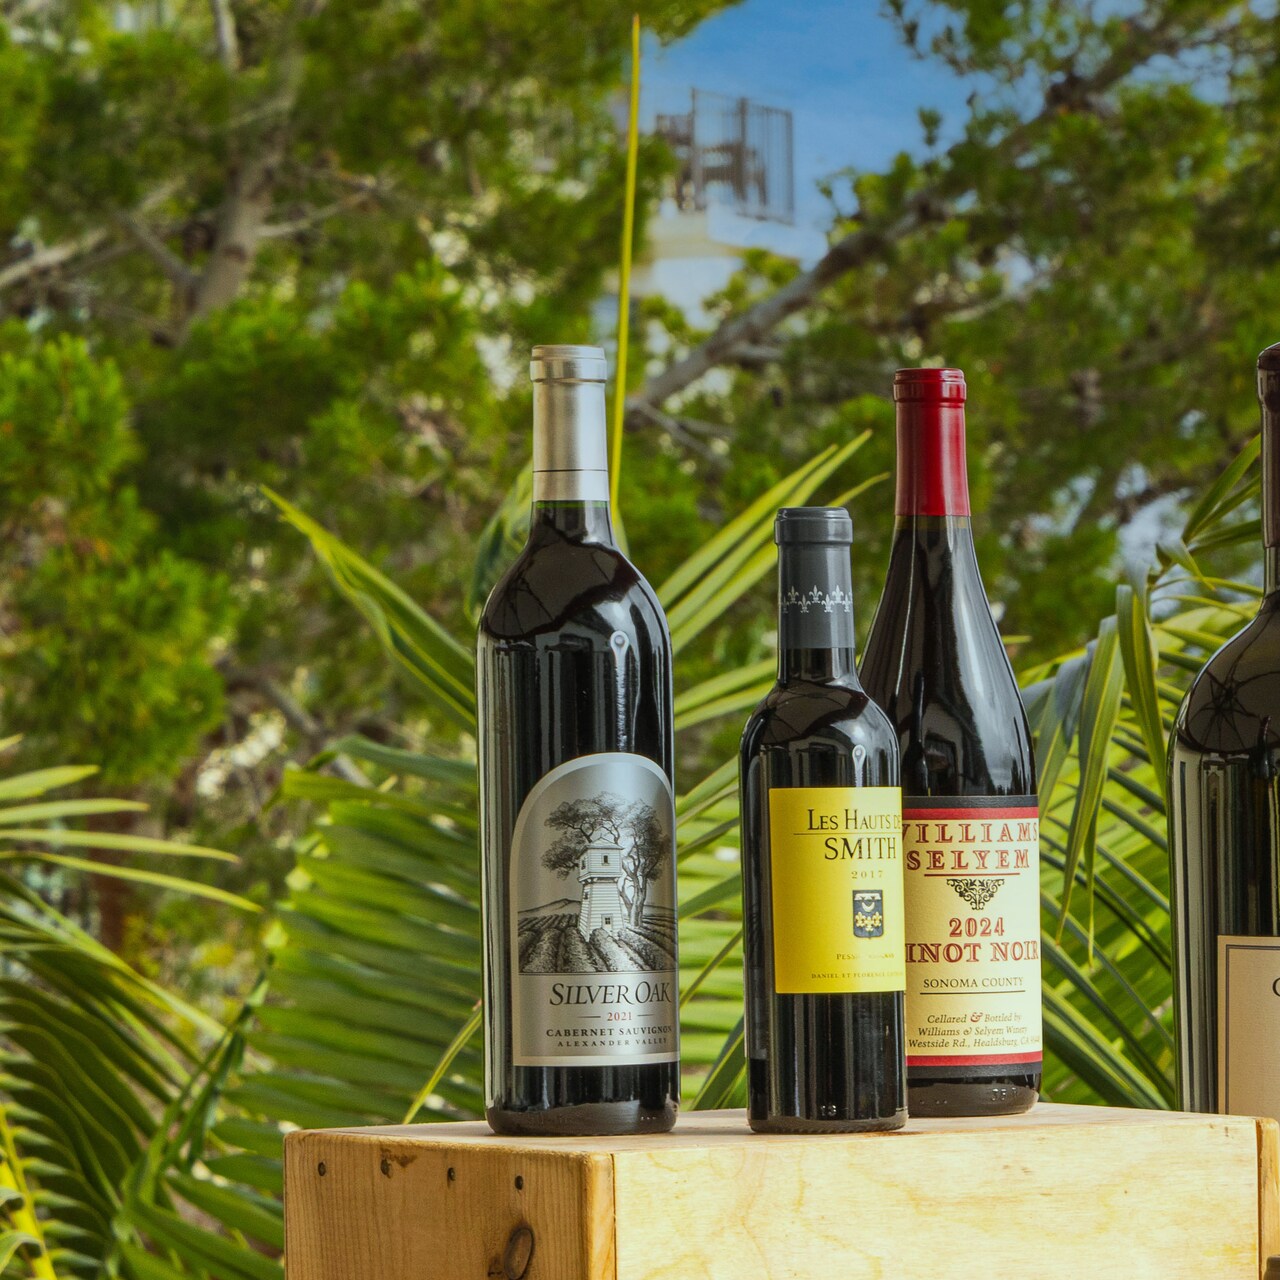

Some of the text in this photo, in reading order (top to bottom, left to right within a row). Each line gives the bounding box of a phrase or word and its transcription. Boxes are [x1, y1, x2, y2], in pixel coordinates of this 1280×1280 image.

[825, 837, 896, 860] SMITH
[906, 849, 1030, 870] SELYEM
[851, 870, 883, 879] 2017
[949, 917, 1005, 937] 2024
[904, 943, 982, 963] INOT
[990, 941, 1039, 961] NOIR
[923, 976, 1025, 988] SONOMA COUNTY
[549, 981, 673, 1006] SILVER OAK
[607, 1011, 632, 1021] 2021
[927, 1013, 967, 1024] Cellared
[970, 1011, 983, 1023] &
[546, 1025, 673, 1038] CABERNET SAUVIGNON
[918, 1026, 961, 1036] Williams
[557, 1039, 631, 1047] ALEXANDER
[908, 1038, 951, 1048] Westside
